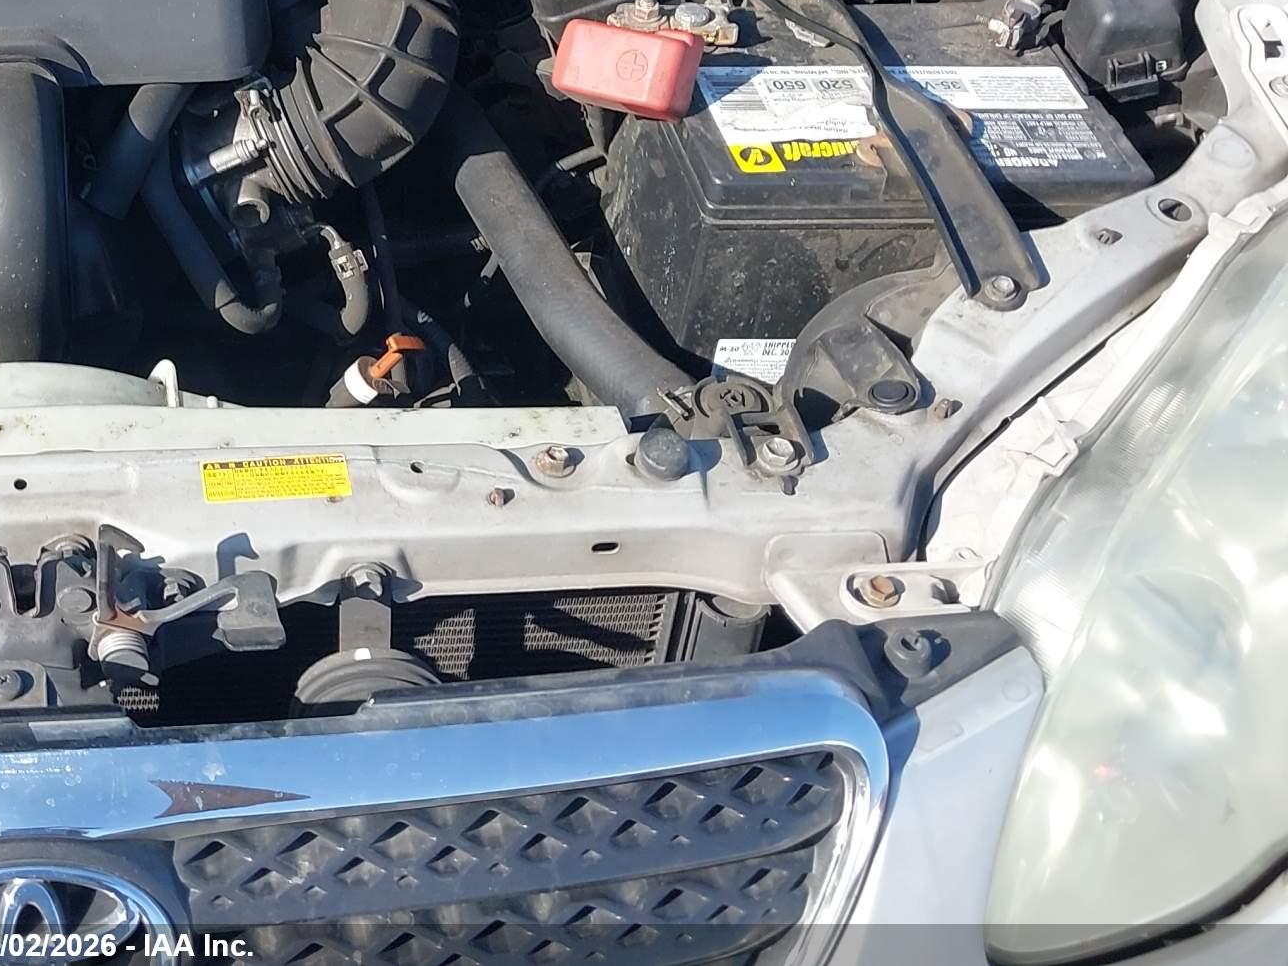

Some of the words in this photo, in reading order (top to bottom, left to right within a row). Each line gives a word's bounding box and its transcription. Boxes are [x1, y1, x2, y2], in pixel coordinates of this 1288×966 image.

[772, 80, 806, 91] 650
[819, 80, 853, 91] 520
[243, 458, 286, 468] CAUTION
